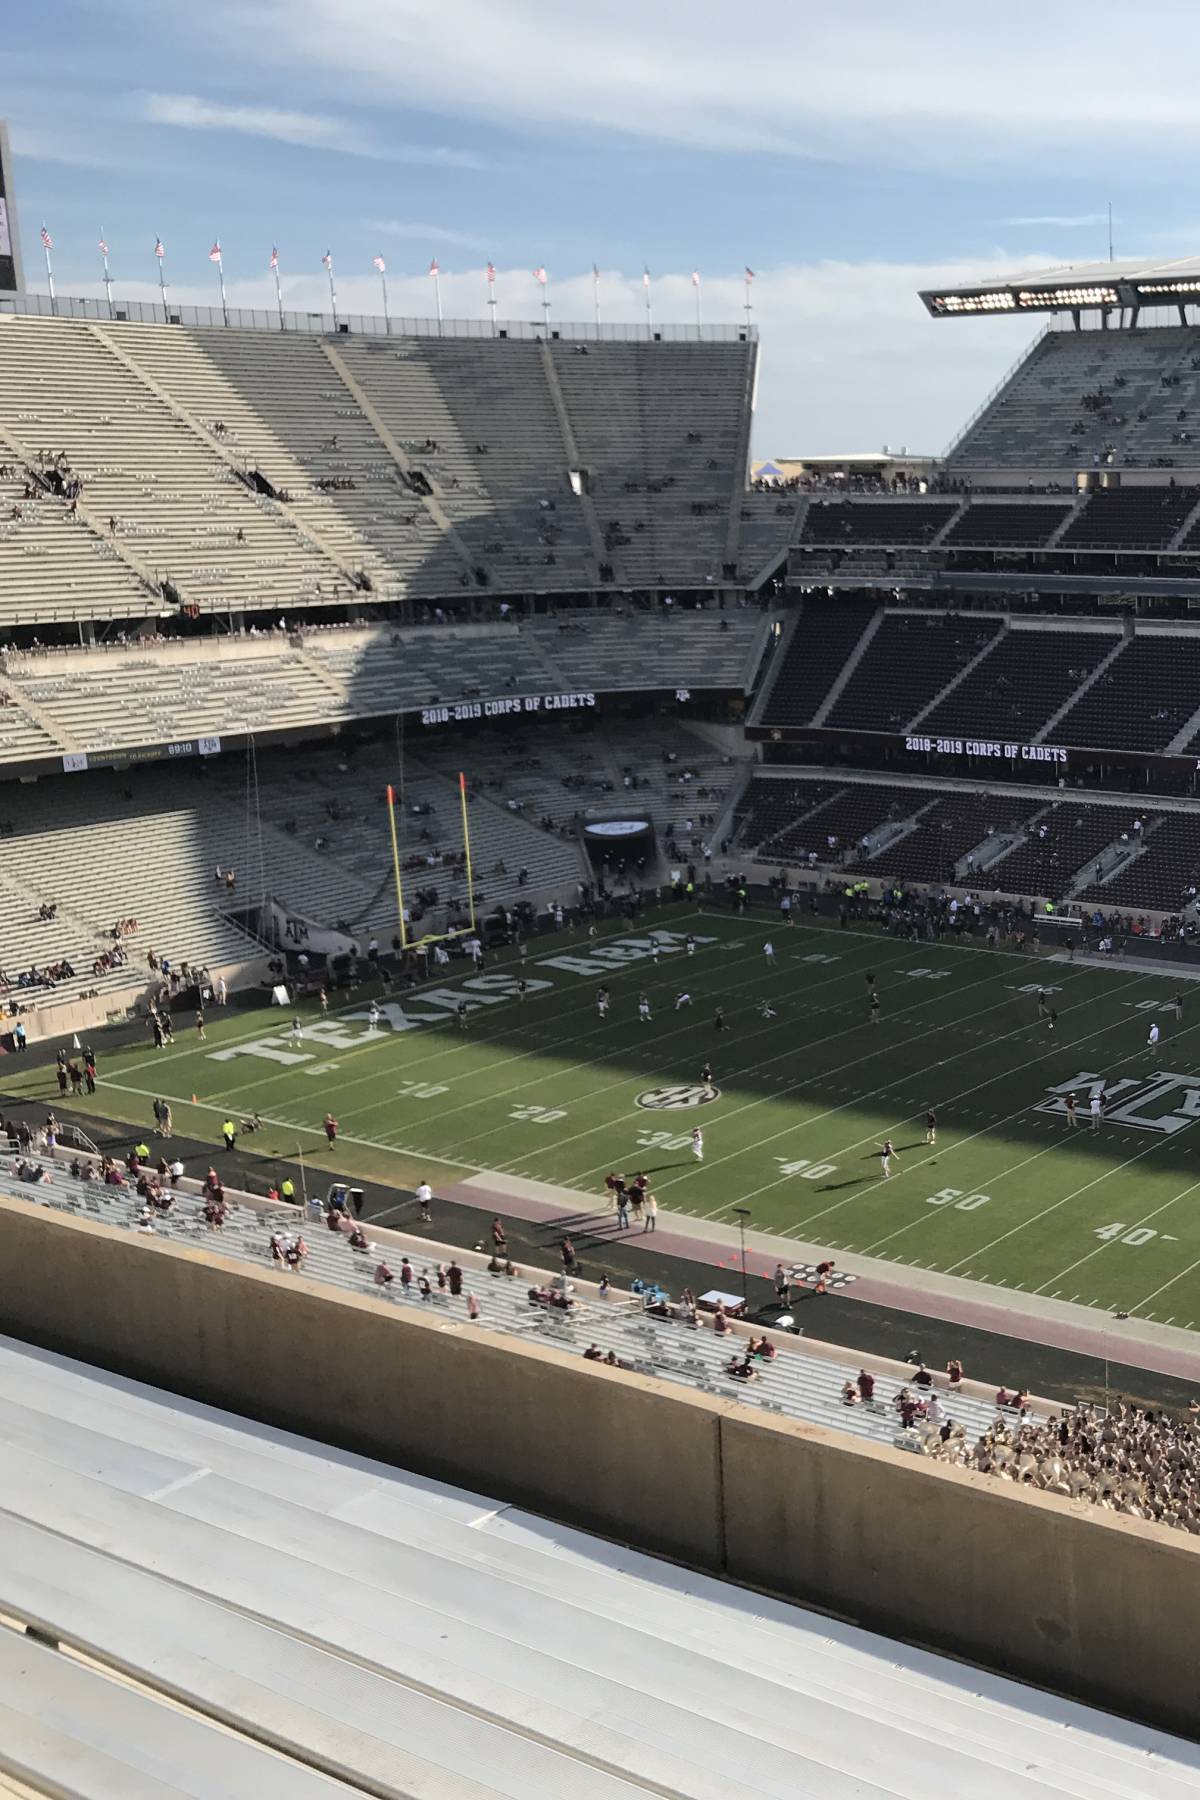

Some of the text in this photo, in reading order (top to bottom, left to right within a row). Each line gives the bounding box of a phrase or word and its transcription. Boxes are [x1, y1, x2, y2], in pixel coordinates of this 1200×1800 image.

[421, 693, 596, 725] 2018-2019 CORPS OF CADETS
[905, 736, 1067, 763] 2018-2019 CORPS OF CADETS
[204, 929, 718, 1066] TEXAS A&M
[398, 1082, 450, 1099] 10
[508, 1105, 568, 1124] 20
[635, 1131, 695, 1151] 30
[778, 1160, 838, 1180] 40
[925, 1187, 991, 1211] 50
[1091, 1222, 1158, 1246] 40
